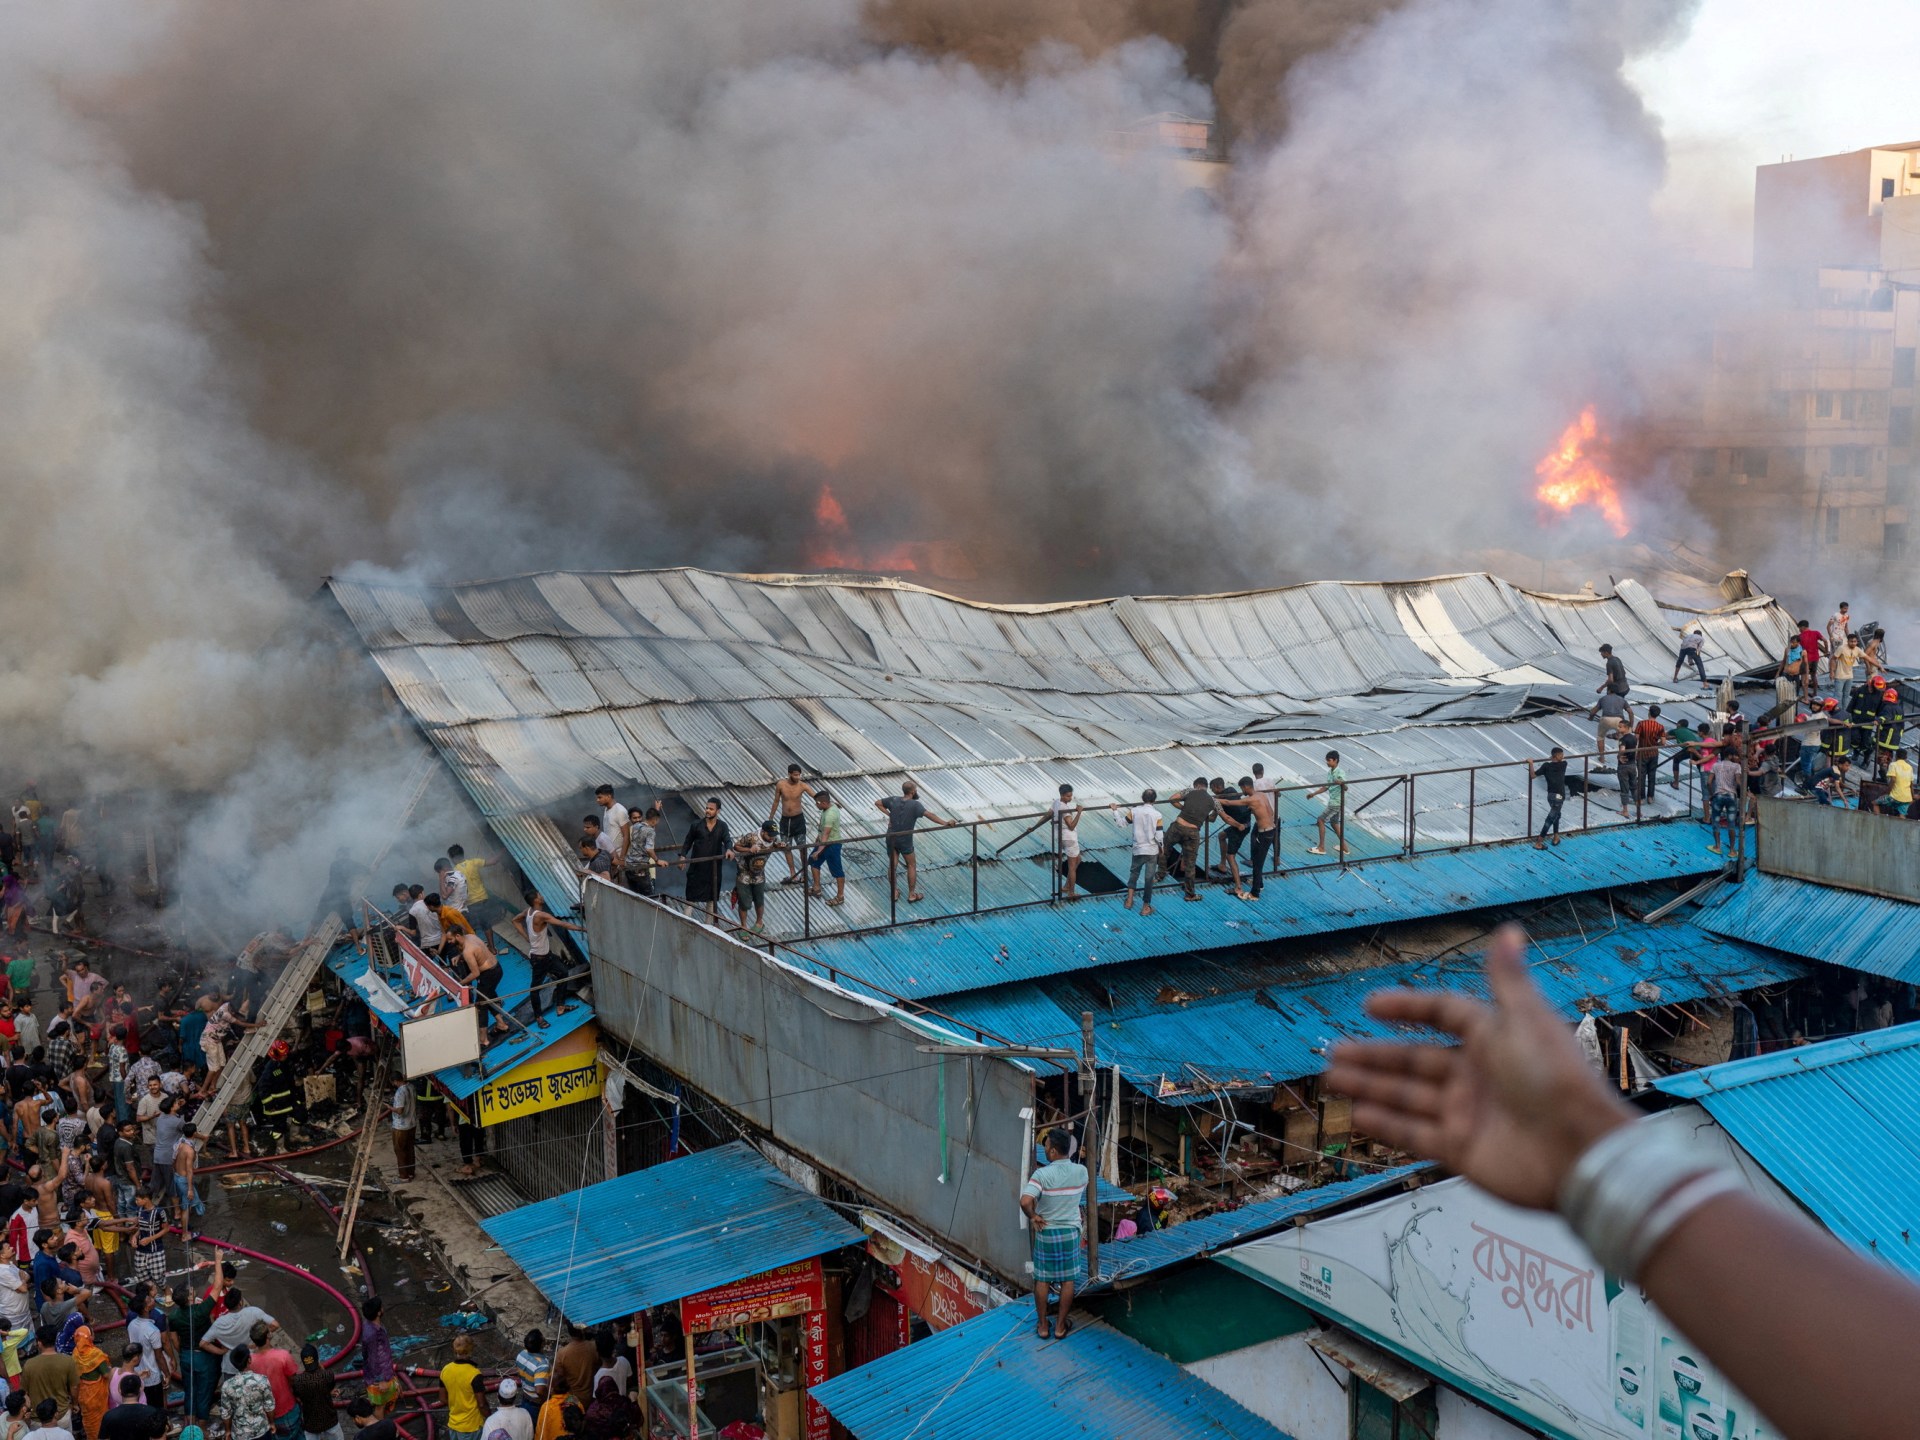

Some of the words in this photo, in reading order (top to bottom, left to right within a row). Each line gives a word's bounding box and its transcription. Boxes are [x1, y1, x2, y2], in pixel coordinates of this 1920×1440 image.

[481, 1081, 494, 1113] দি
[497, 1077, 543, 1110] শুভেচ্ছা
[777, 1260, 814, 1275] ভান্ডার
[1470, 1220, 1595, 1333] বসুন্ধরা
